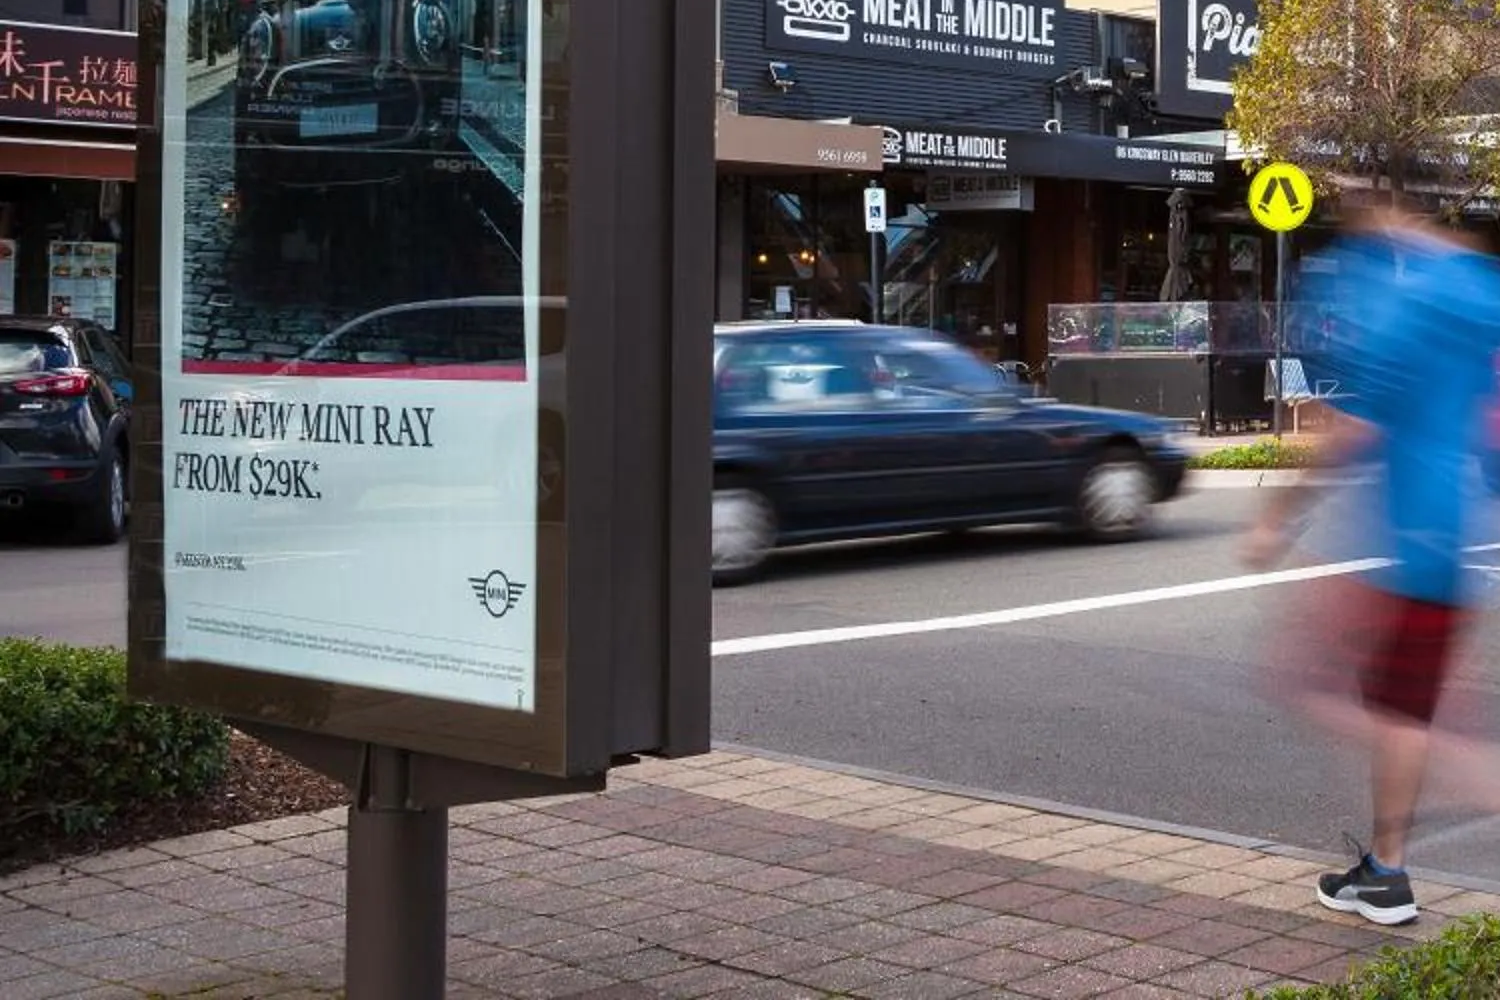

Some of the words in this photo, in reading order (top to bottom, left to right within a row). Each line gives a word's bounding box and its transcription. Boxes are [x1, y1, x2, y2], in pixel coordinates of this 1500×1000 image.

[936, 13, 959, 36] THE
[863, 32, 912, 49] CHARCOAL
[973, 45, 1013, 61] GOURMET
[1016, 50, 1056, 66] BURGERS
[906, 131, 944, 155] MEAT
[957, 135, 1007, 160] MIDDLE
[1161, 149, 1178, 162] GLEN
[179, 399, 226, 437] THE
[230, 400, 296, 441] NEW
[298, 403, 365, 445] MINI
[372, 406, 435, 447] RAY
[173, 452, 242, 493] FROM
